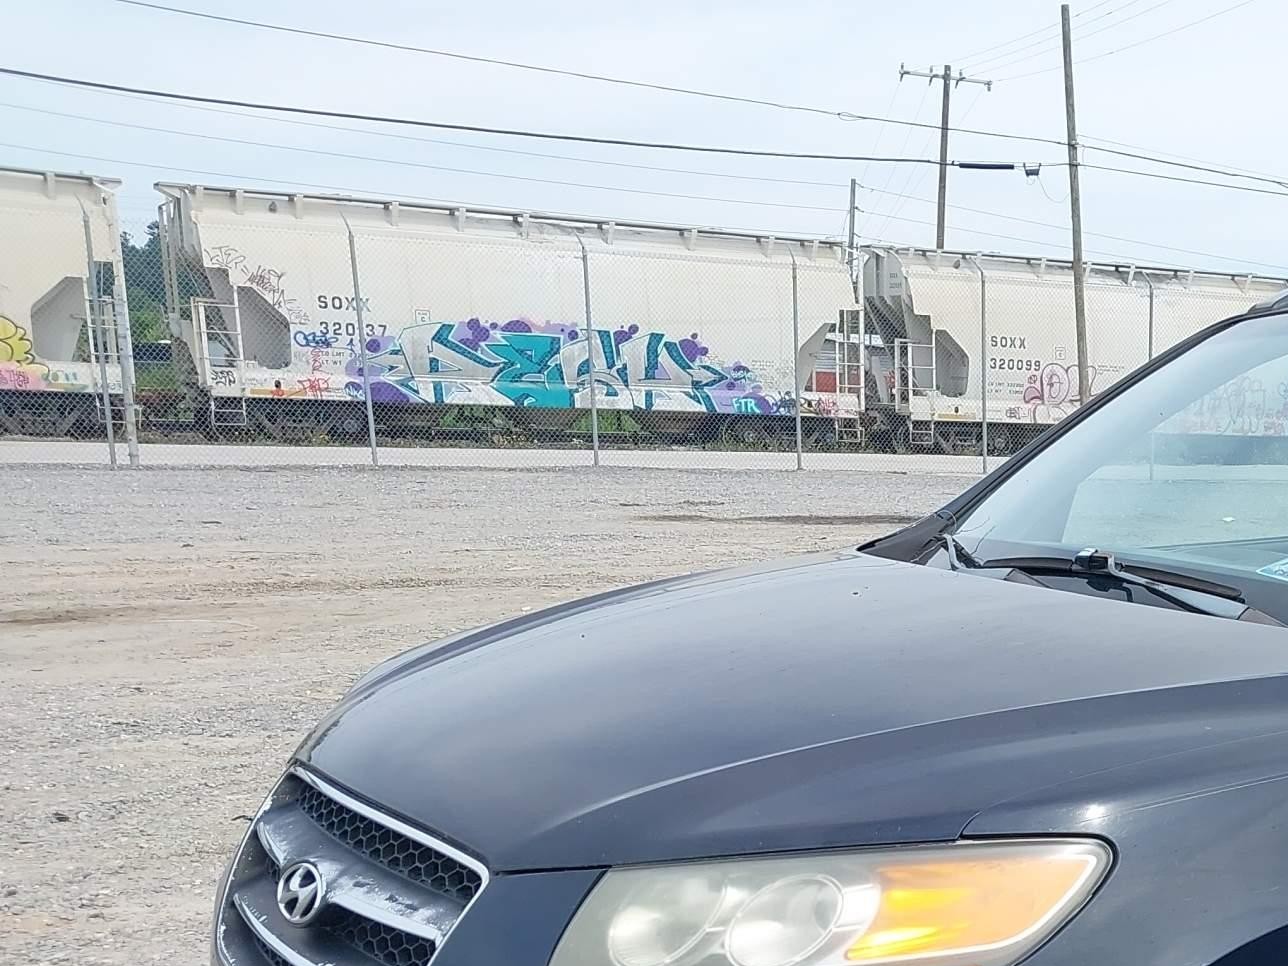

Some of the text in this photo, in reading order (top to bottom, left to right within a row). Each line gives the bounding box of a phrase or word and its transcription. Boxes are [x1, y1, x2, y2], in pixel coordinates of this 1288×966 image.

[317, 295, 371, 313] SOXX
[319, 321, 387, 338] 32037
[990, 335, 1026, 349] SOXX
[989, 357, 1041, 371] 320099
